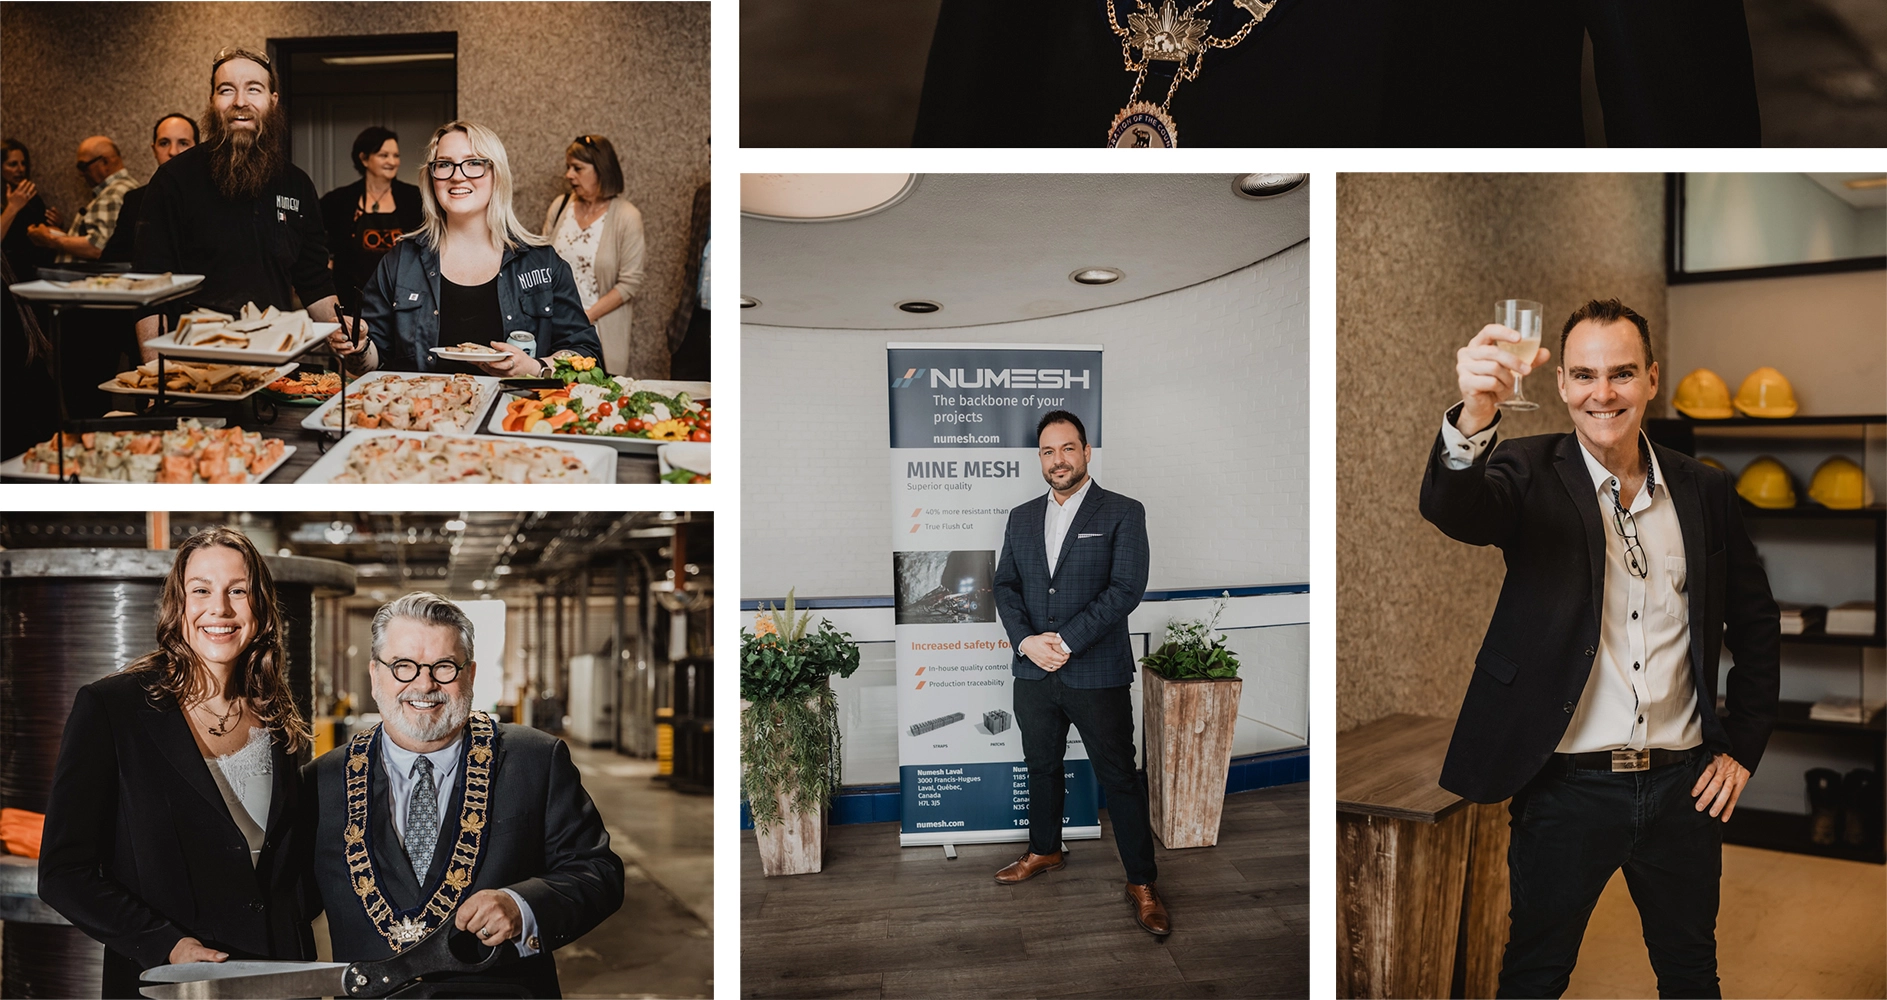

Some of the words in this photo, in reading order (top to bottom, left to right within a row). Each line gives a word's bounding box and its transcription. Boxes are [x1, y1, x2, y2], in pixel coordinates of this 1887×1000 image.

[1133, 114, 1143, 122] OF
[1145, 115, 1157, 126] THE
[1157, 124, 1171, 148] COUN
[930, 368, 1090, 389] NUMESH
[933, 394, 956, 406] The
[959, 394, 1018, 407] backbone
[1021, 394, 1036, 407] of
[1037, 397, 1065, 409] your
[933, 410, 983, 425] projects
[933, 433, 1000, 444] numesh.com
[907, 461, 958, 478] MINE
[963, 461, 1020, 478] MESH
[907, 482, 942, 491] Superior
[944, 482, 972, 491] quality
[961, 507, 991, 515] resistant
[993, 507, 1009, 515] than
[912, 640, 961, 650] Increased
[963, 639, 995, 651] safety
[960, 664, 983, 672] quality
[984, 663, 1009, 671] control
[967, 678, 1005, 687] traceability
[916, 820, 965, 828] numesh.com
